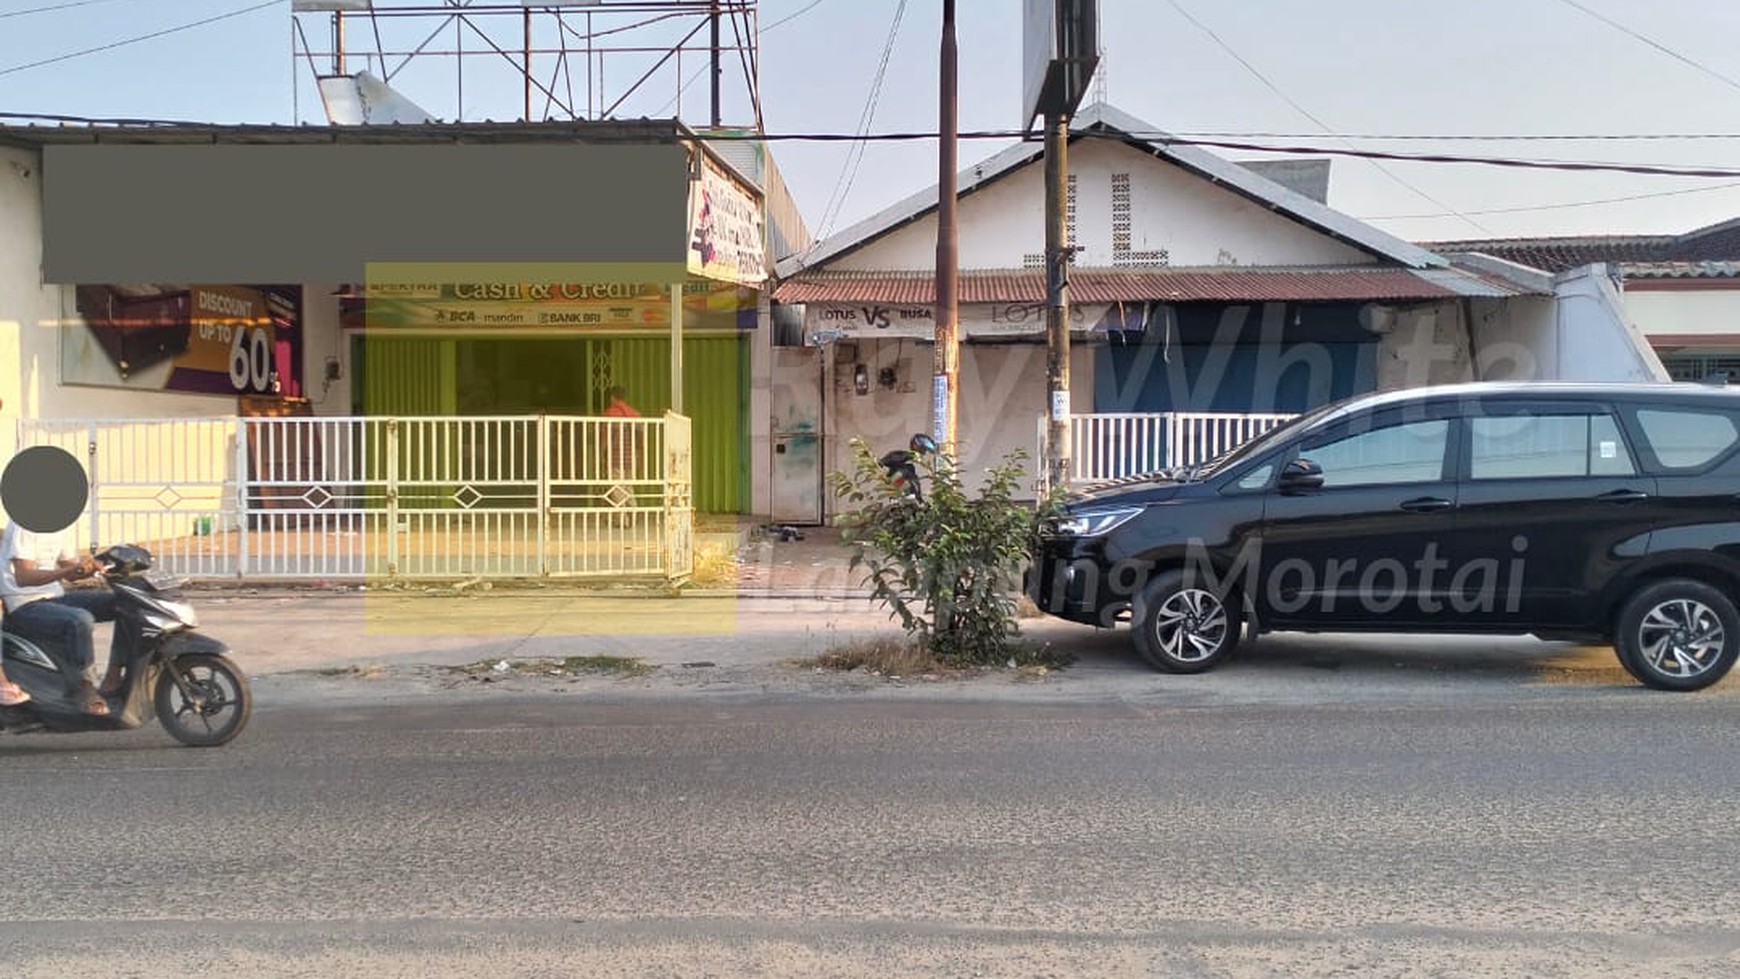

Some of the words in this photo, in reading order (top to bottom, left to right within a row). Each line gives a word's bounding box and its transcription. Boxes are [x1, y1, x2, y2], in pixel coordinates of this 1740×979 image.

[454, 282, 520, 299] Cash
[530, 282, 551, 299] &
[199, 290, 253, 318] DISCOUNT
[991, 303, 1086, 324] LOTS
[549, 313, 581, 323] BANK
[583, 313, 602, 324] BRI
[819, 309, 856, 321] LOTUS
[862, 304, 891, 329] VS
[199, 321, 217, 341] UP
[217, 325, 232, 344] TO
